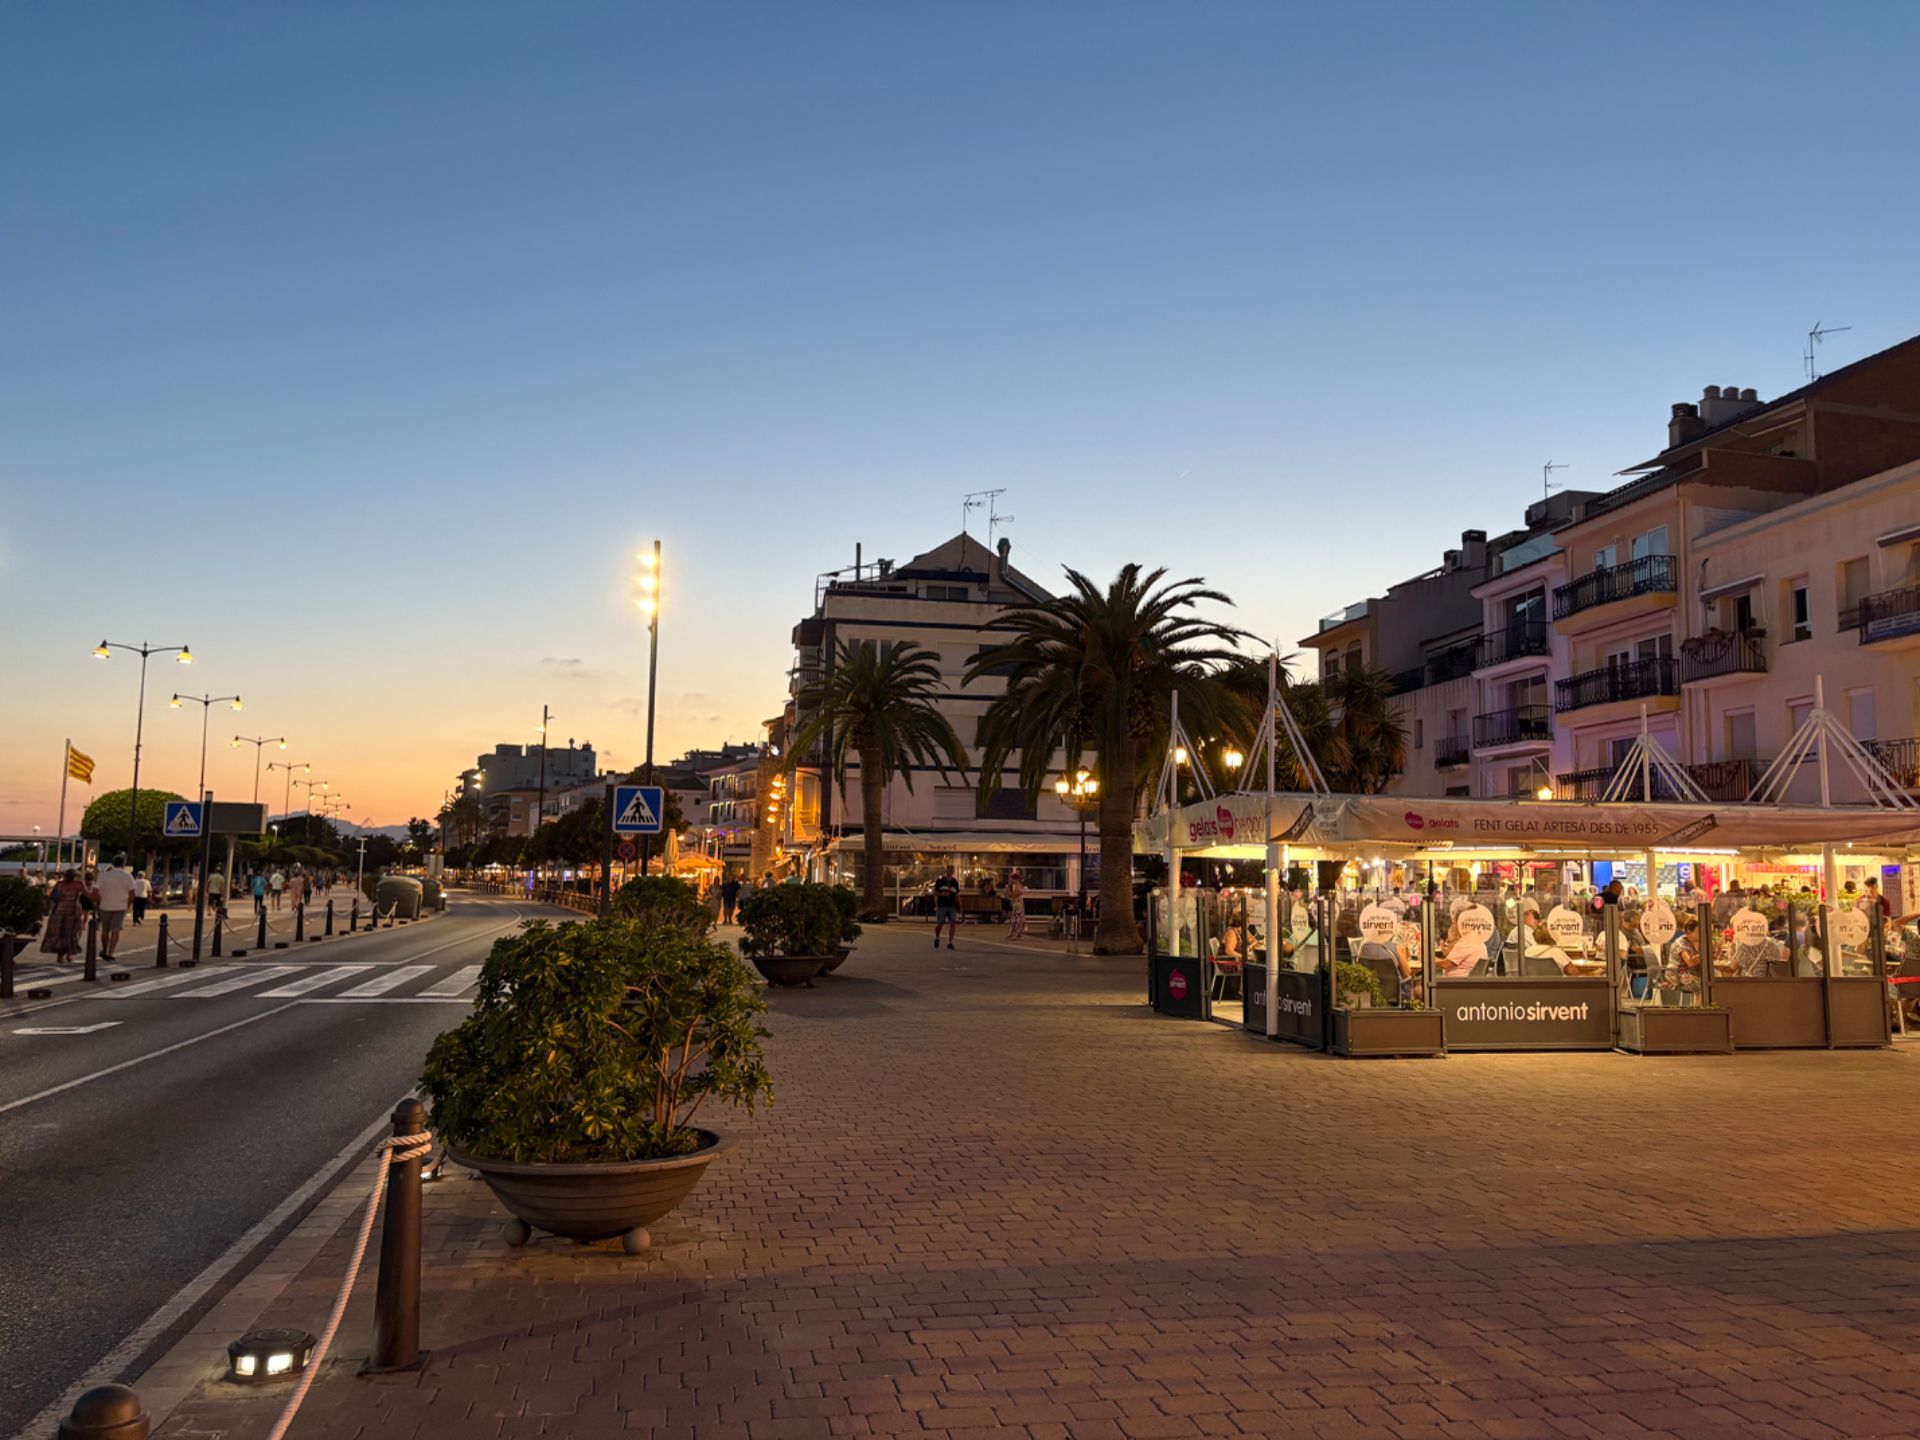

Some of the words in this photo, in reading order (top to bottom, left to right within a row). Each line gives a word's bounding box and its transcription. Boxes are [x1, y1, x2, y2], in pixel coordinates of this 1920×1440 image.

[1189, 816, 1219, 842] gelats
[1429, 818, 1460, 830] gelats
[1474, 818, 1502, 831] FENT
[1505, 820, 1539, 832] GELAT
[1590, 822, 1612, 834] DES
[1615, 822, 1629, 834] DE
[1633, 823, 1659, 835] 1955
[1362, 919, 1394, 930] sirvent
[1549, 921, 1581, 931] sirvent
[1456, 1001, 1589, 1021] antoniosirvent
